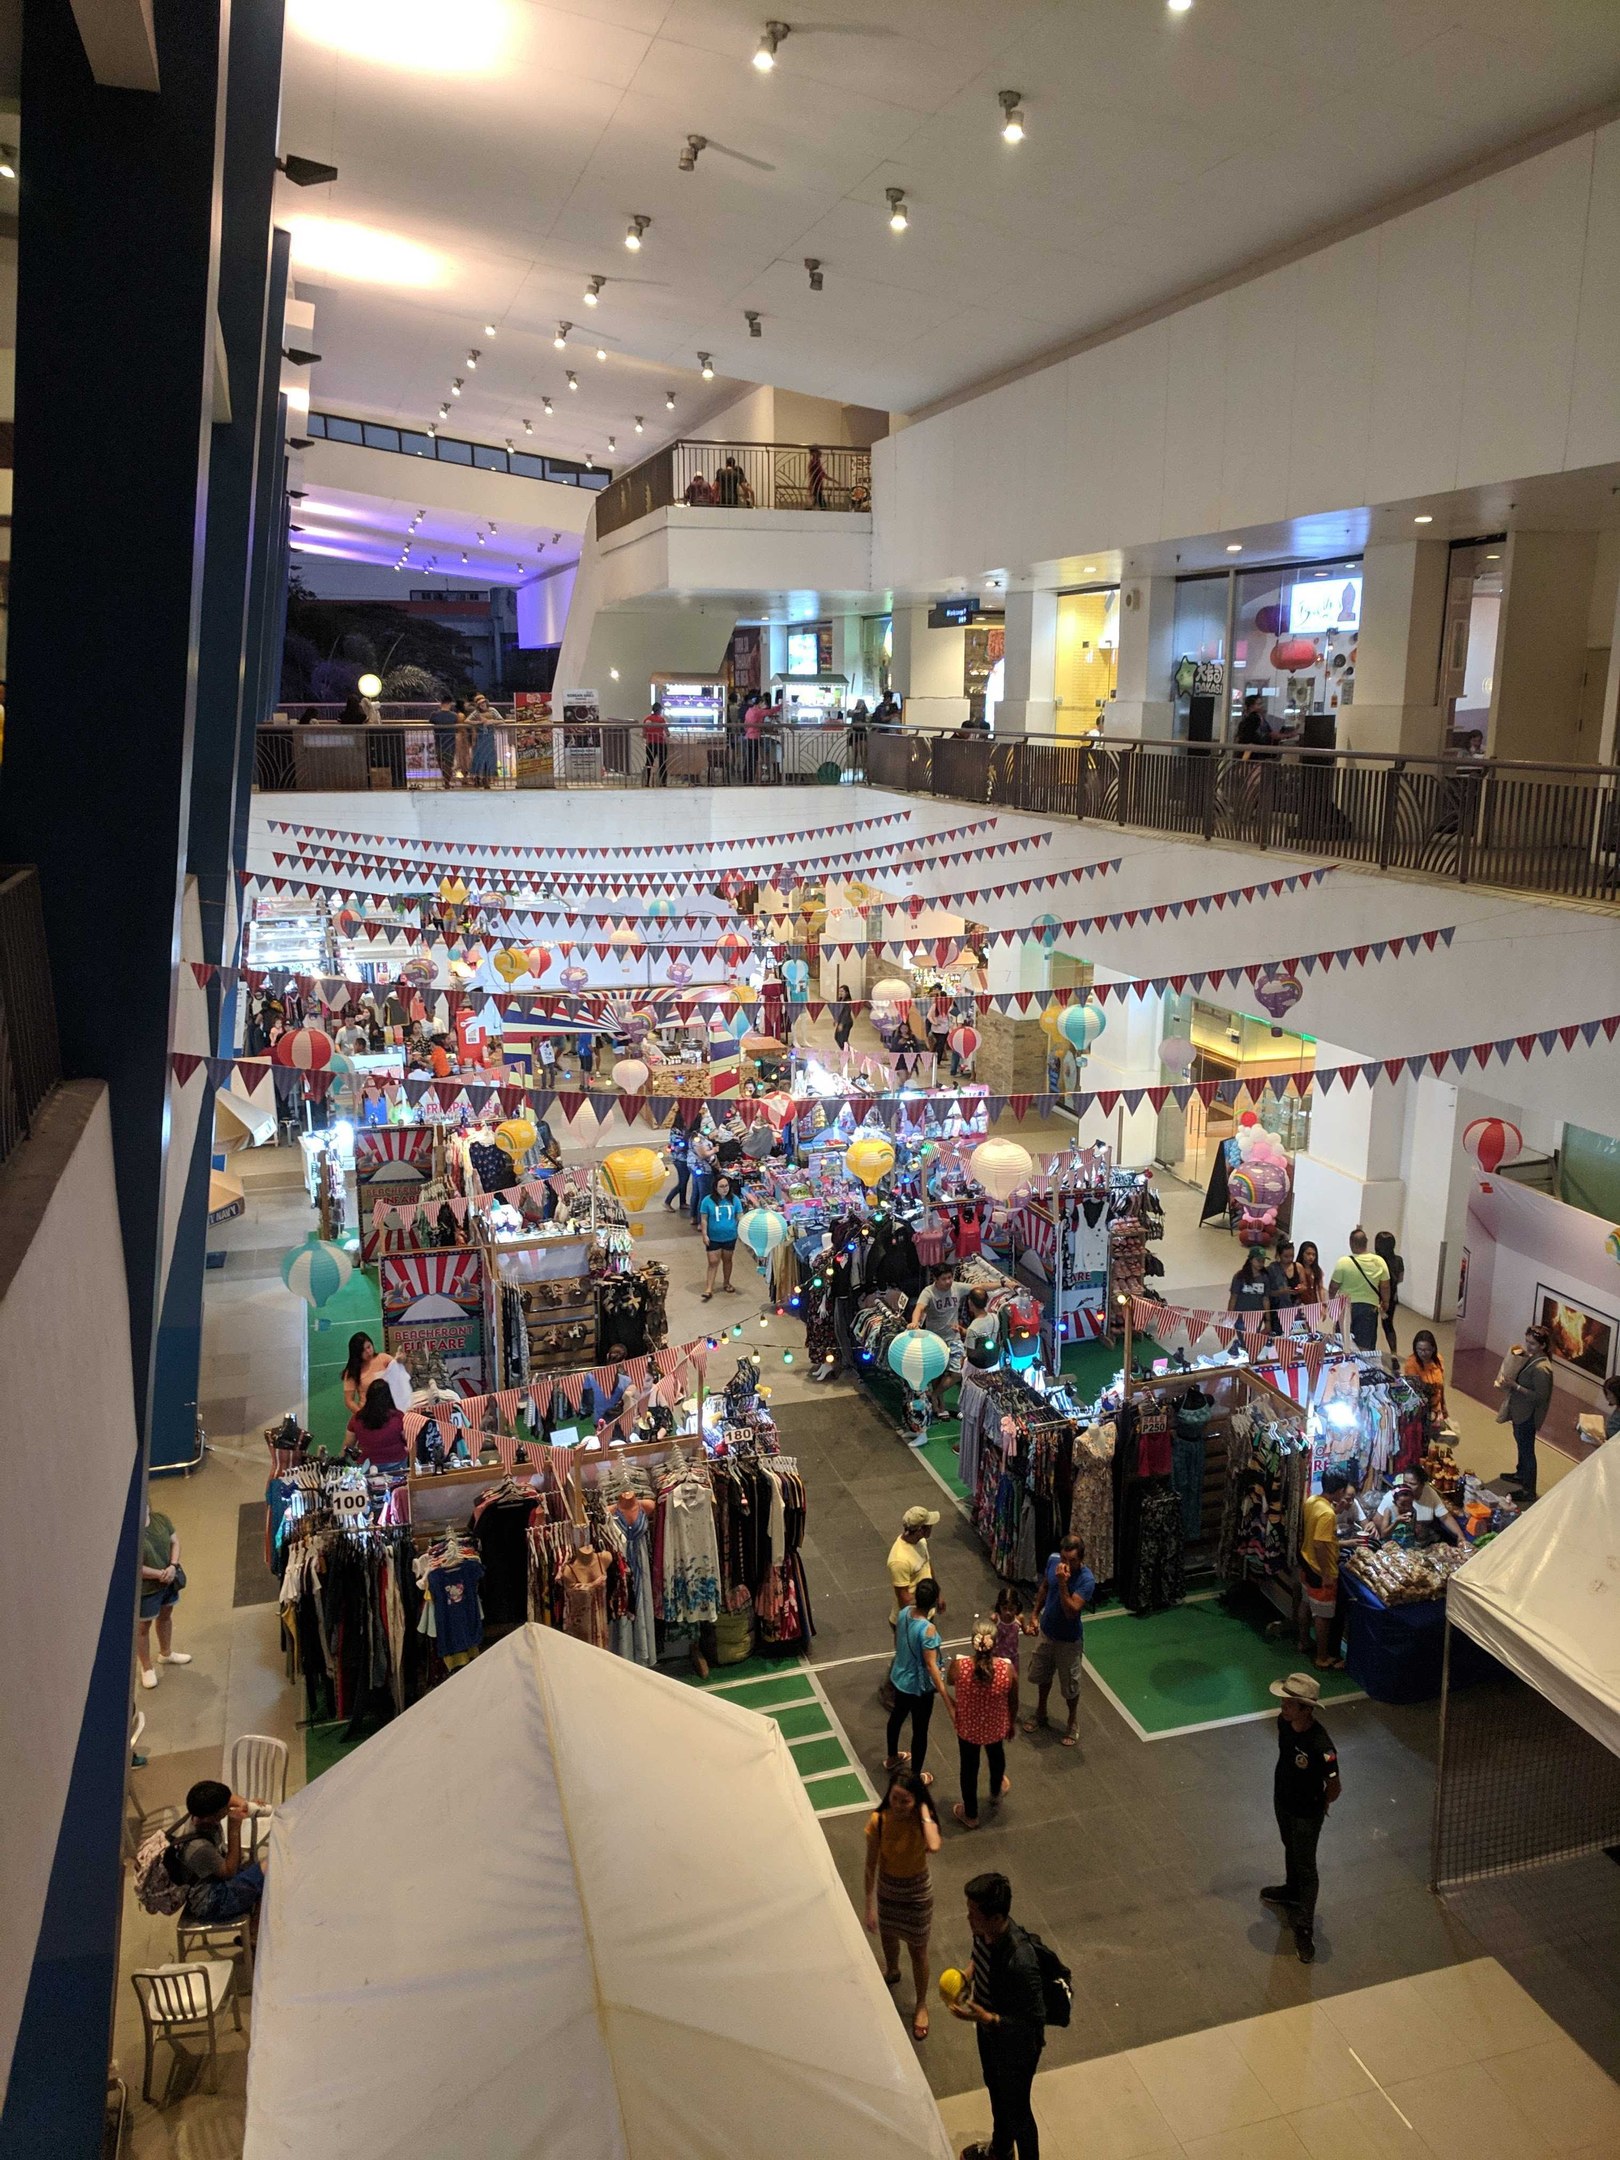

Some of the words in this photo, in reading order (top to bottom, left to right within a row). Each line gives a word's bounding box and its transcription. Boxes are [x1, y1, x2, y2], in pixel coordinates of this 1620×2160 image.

[935, 1296, 958, 1310] GAP
[394, 1325, 473, 1341] BEACHFRONT
[726, 1429, 751, 1441] 180
[1142, 1424, 1165, 1432] P250
[334, 1495, 366, 1510] 100
